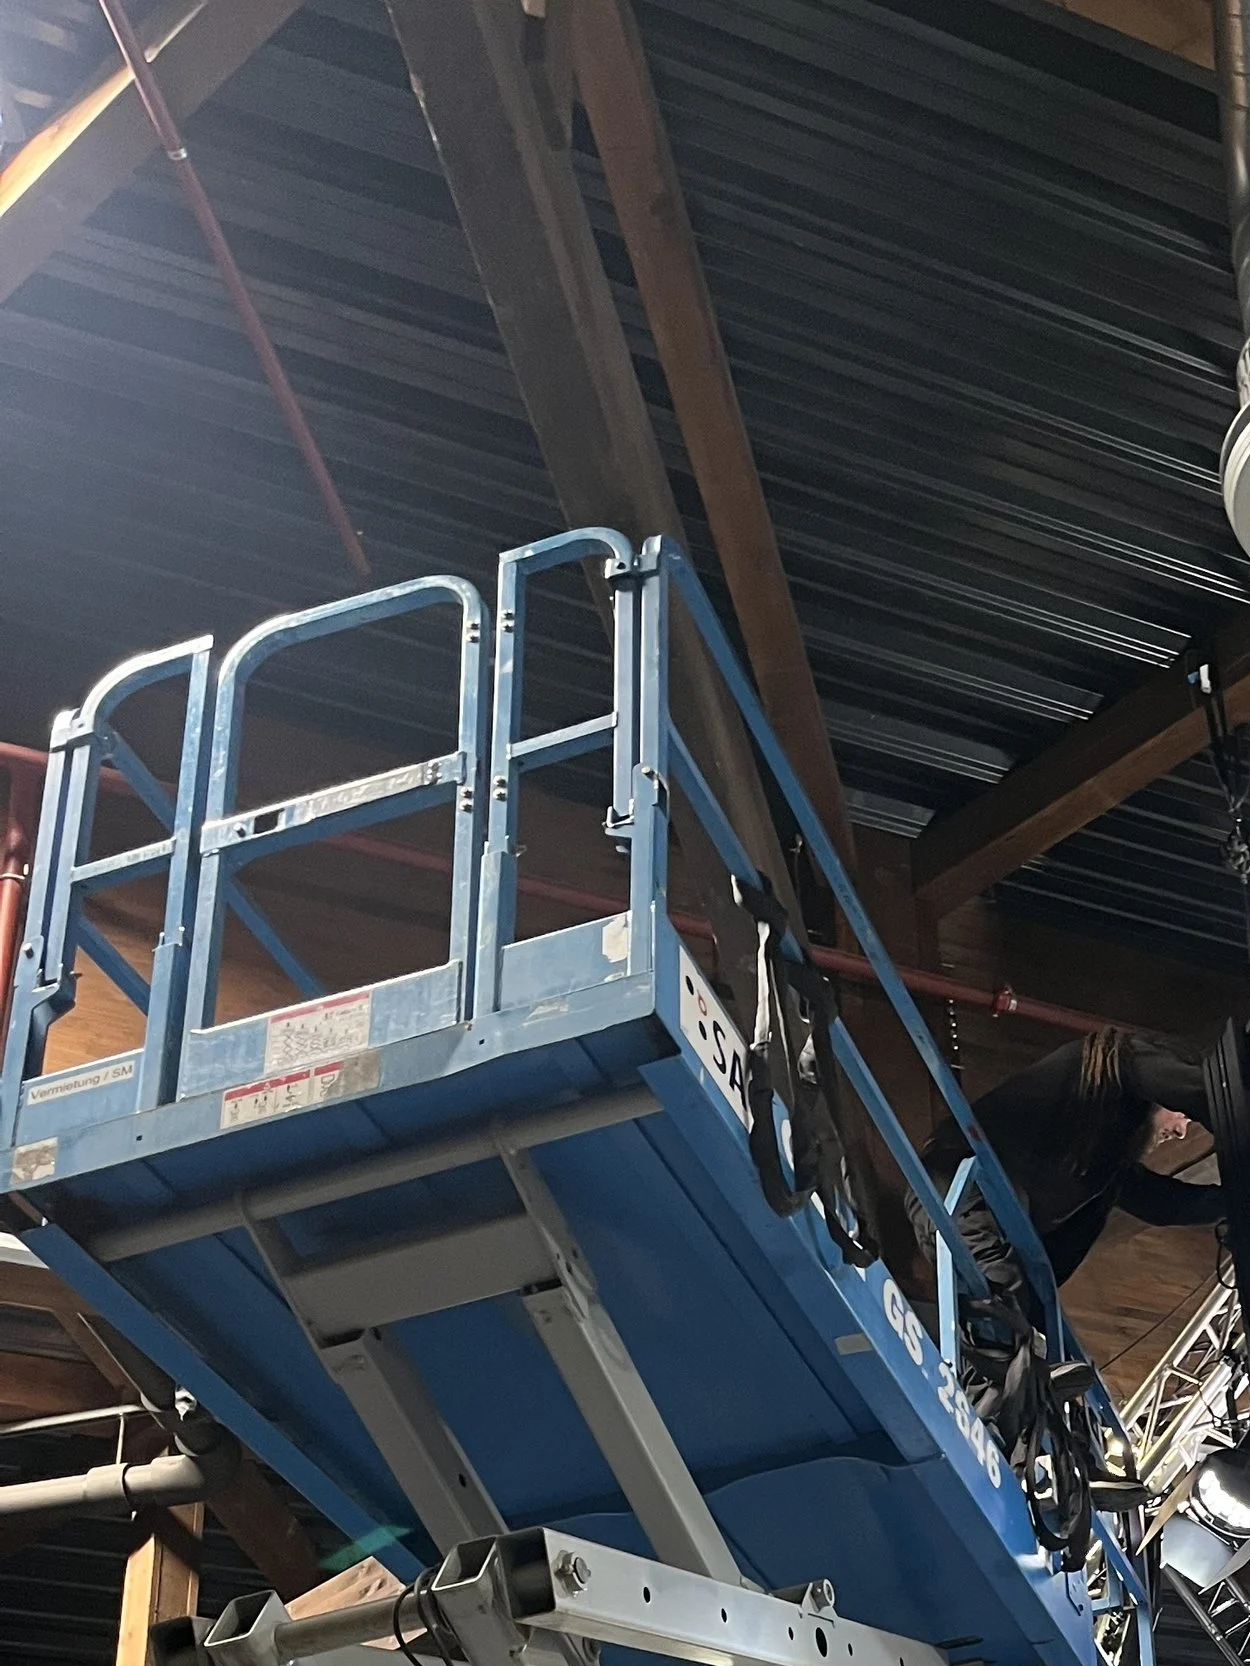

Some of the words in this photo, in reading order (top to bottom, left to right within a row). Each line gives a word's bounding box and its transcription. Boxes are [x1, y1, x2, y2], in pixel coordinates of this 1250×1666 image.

[30, 1074, 101, 1101] Vermietung
[111, 1063, 133, 1080] SM
[883, 1278, 924, 1367] GS
